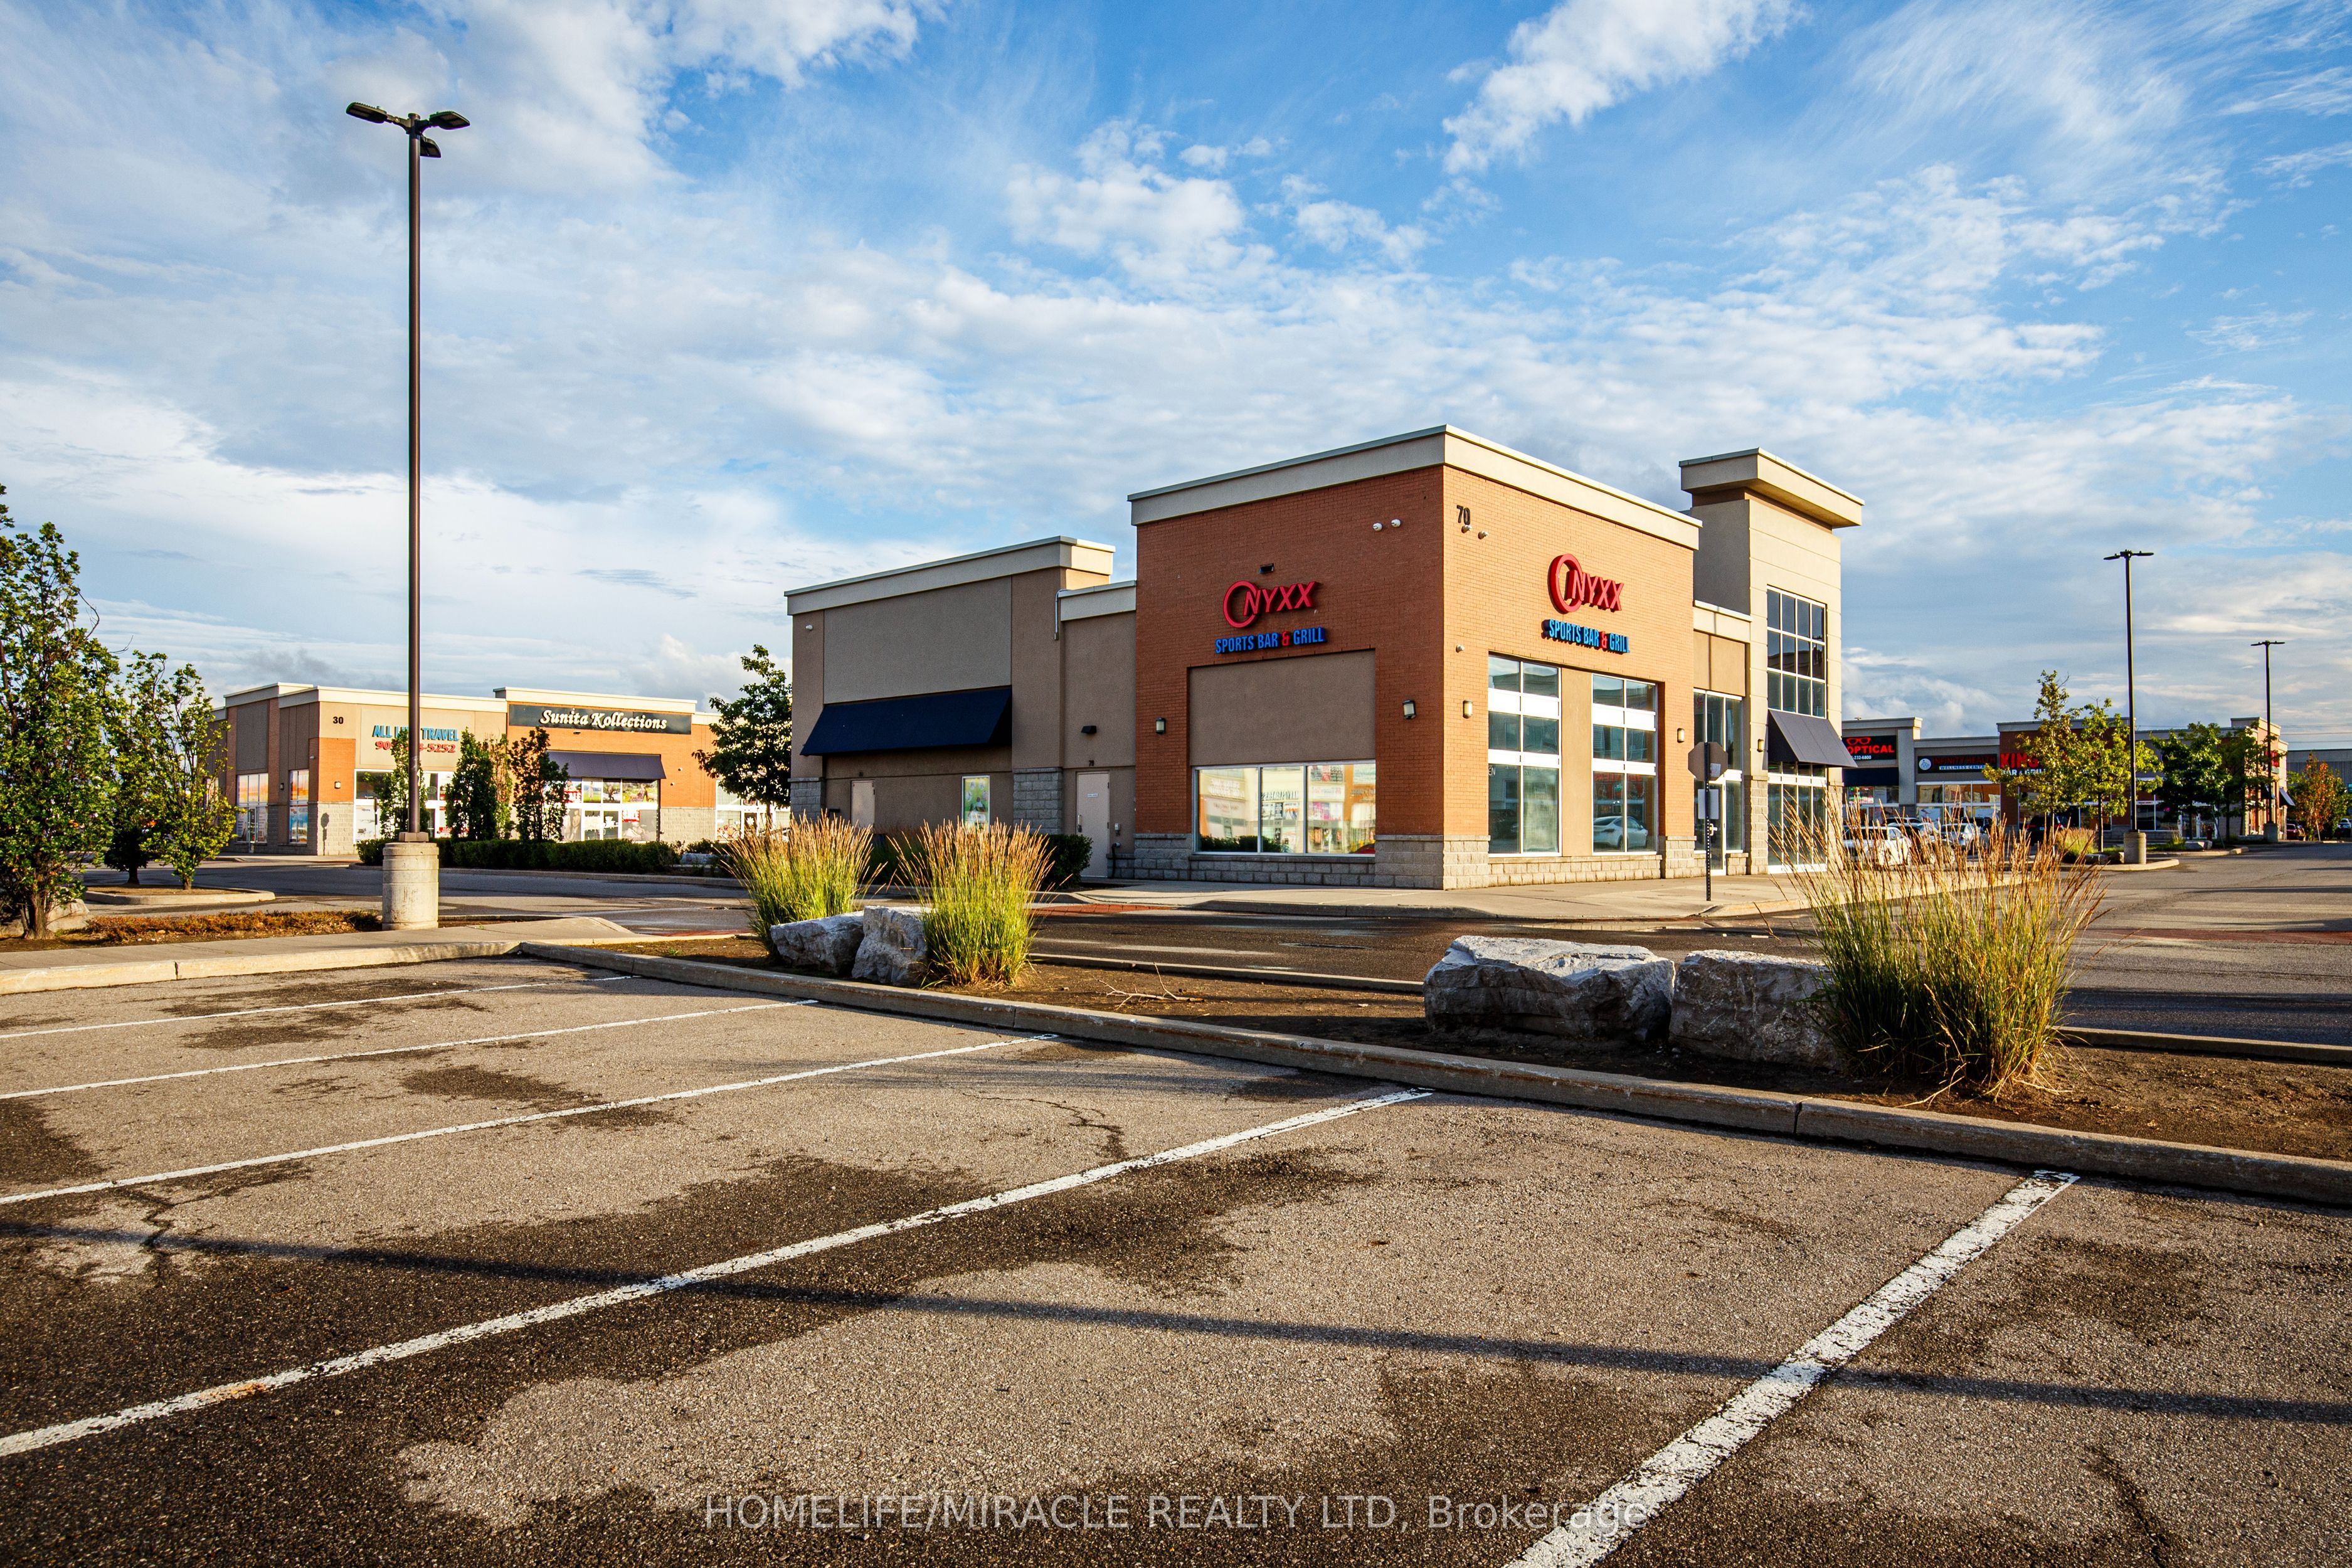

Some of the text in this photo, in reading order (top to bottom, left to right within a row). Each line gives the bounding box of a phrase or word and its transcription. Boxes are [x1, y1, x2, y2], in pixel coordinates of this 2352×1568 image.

[1456, 505, 1470, 525] 70
[1547, 553, 1624, 615] ONYXX
[1223, 580, 1317, 629] ONYXX
[1215, 627, 1326, 654] SPORTS BAR & GRILL
[1547, 618, 1630, 654] SPORTS BAR & GRILL
[332, 716, 344, 724] 30
[540, 707, 667, 729] Sunita Kollections
[373, 725, 393, 738] ALL
[421, 727, 459, 741] TRAVEL
[1846, 744, 1894, 755] OPTICAL
